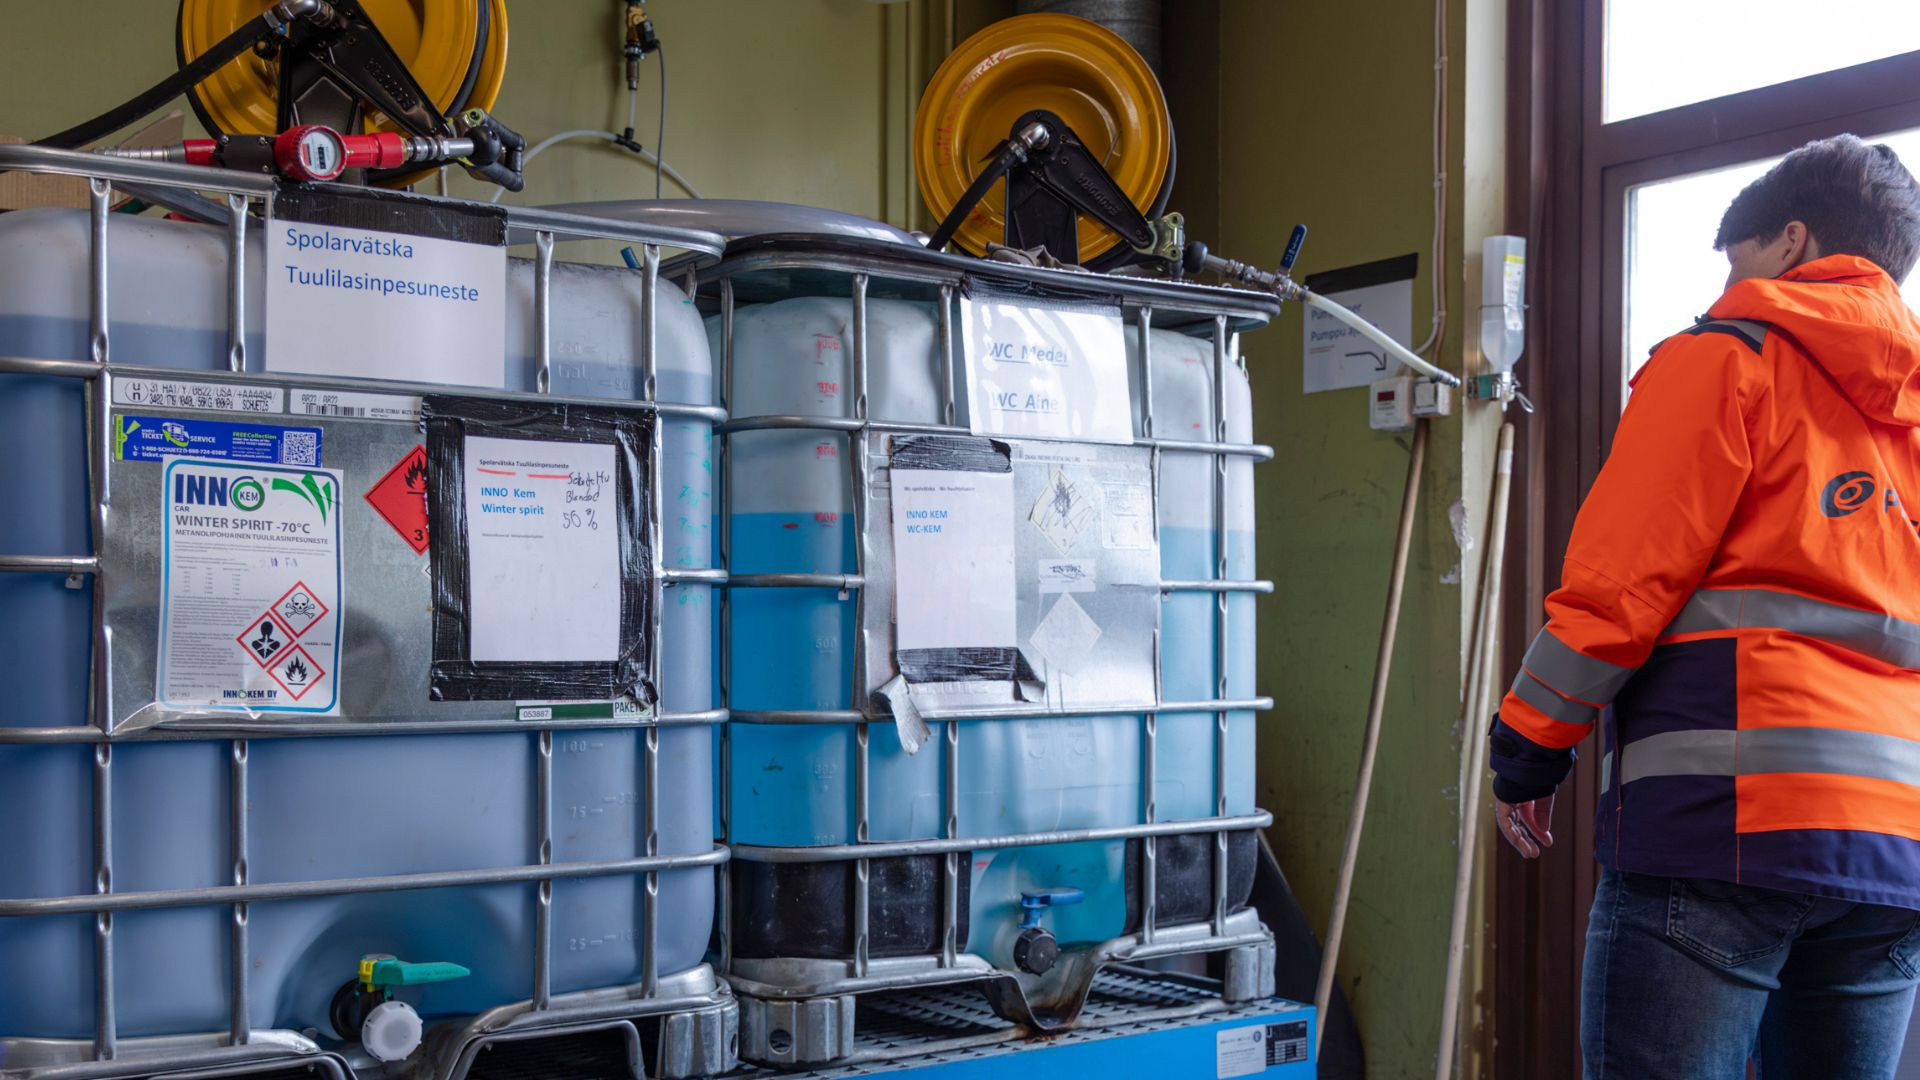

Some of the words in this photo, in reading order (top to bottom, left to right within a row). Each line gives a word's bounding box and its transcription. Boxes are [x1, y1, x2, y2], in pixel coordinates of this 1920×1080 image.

[286, 228, 413, 258] Spolarvätska
[285, 266, 479, 301] Tuulilasinpesuneste
[239, 491, 259, 502] KEM
[481, 487, 509, 497] INNO
[514, 488, 536, 498] Kem
[481, 503, 516, 513] Winter
[519, 504, 545, 517] spirit
[906, 510, 928, 519] INNO
[930, 510, 948, 519] KEM
[175, 514, 229, 529] WINTER
[232, 518, 273, 532] SPIRIT
[276, 522, 311, 534] -70°C
[906, 524, 942, 534] WC-KEM
[175, 529, 251, 540] METANOLIPOHJAINEN
[252, 534, 329, 545] TUULILASINPESUNESTE
[414, 529, 423, 541] 3
